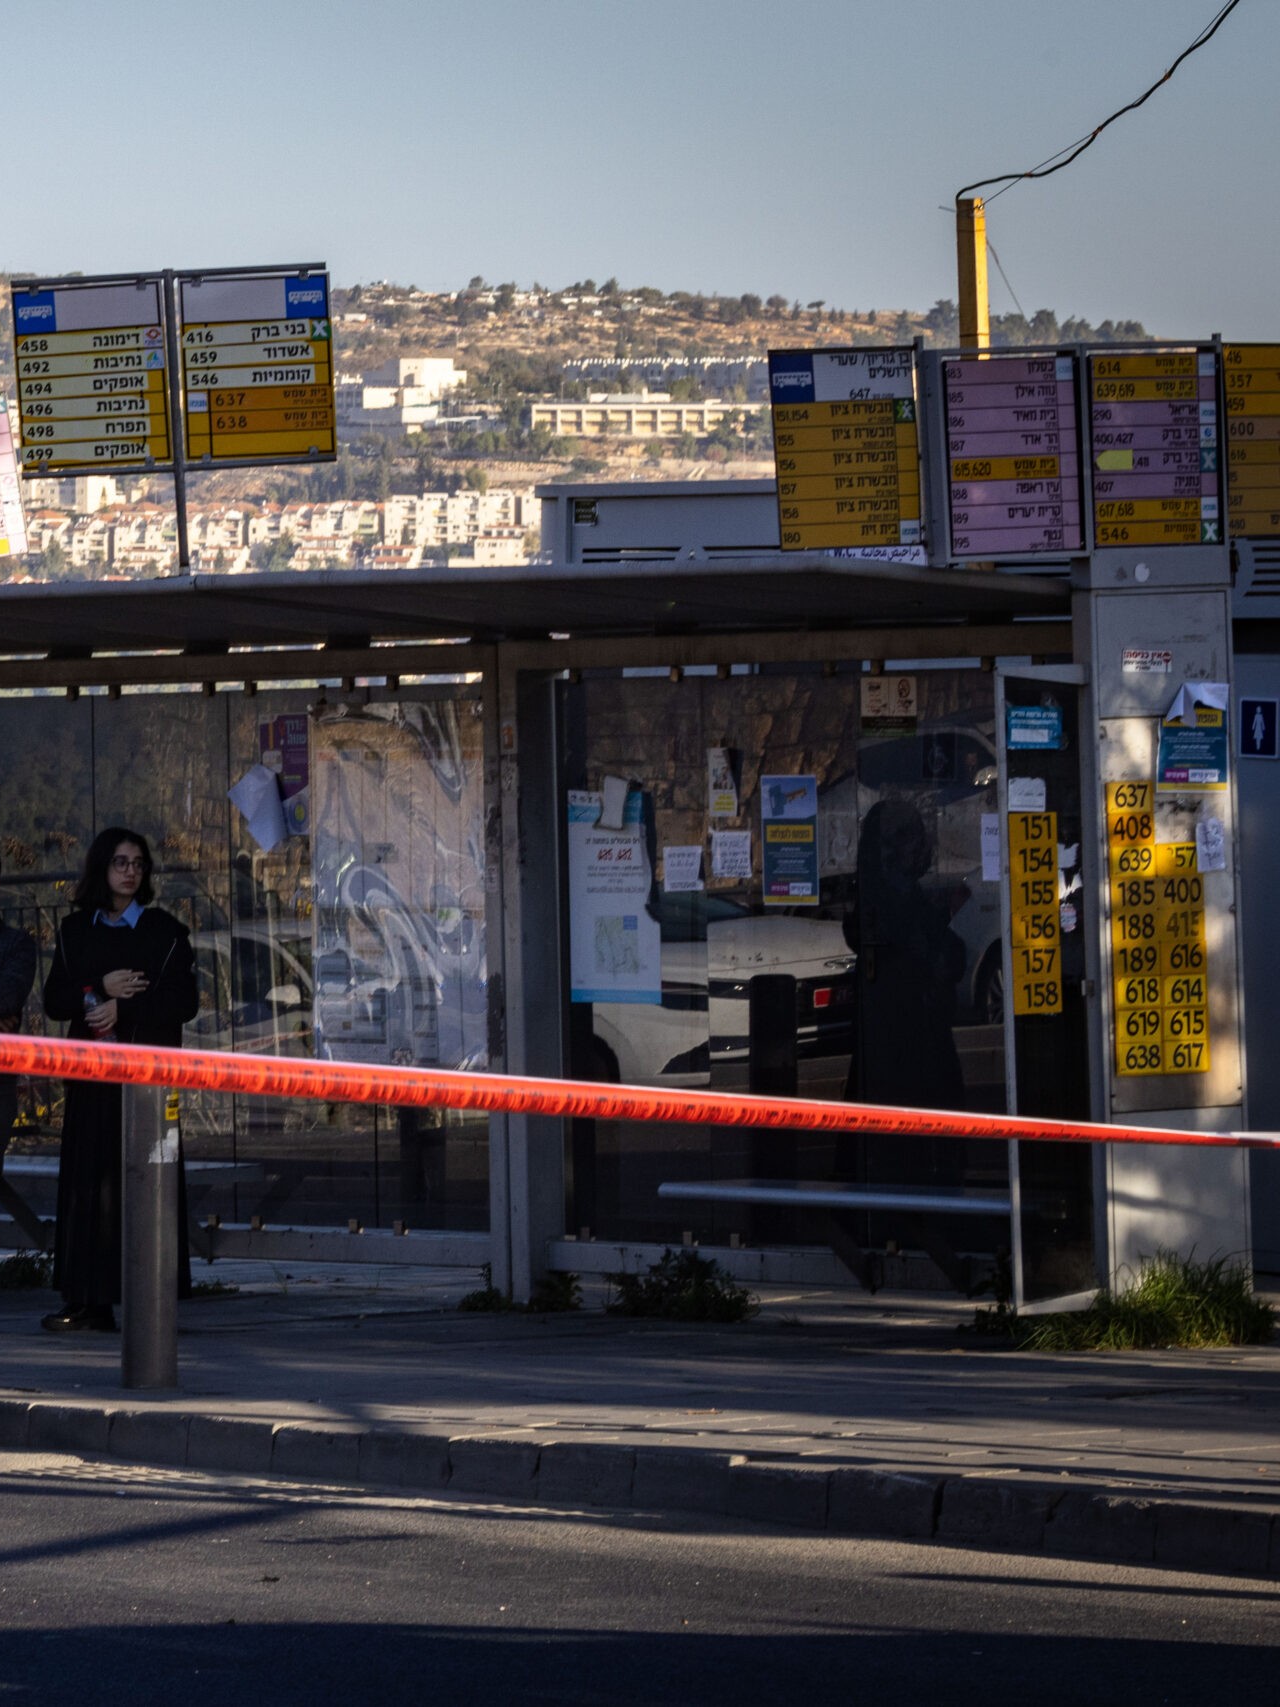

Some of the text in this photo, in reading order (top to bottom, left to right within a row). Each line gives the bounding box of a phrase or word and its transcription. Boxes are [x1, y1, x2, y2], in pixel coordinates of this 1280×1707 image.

[187, 331, 214, 344] 416
[251, 323, 306, 342] בני ברק
[20, 340, 48, 353] 458
[93, 333, 140, 347] דימונה
[190, 352, 218, 364] 459
[262, 344, 309, 358] אשדוד
[22, 361, 50, 373] 492
[93, 356, 142, 369] נתיבות
[1027, 361, 1054, 374] כסלון
[1098, 361, 1121, 375] 614
[191, 373, 218, 386] 546
[252, 368, 311, 383] קוממיות
[1229, 374, 1252, 388] 357
[25, 383, 52, 395] 494
[93, 375, 144, 393] אופקים
[1097, 383, 1135, 399] 639,619
[215, 393, 246, 407] 637
[849, 388, 871, 400] 647
[25, 404, 53, 416] 496
[96, 398, 145, 412] נתיבות
[852, 402, 892, 415] מבשרת
[1227, 398, 1245, 411] 459
[217, 415, 248, 429] 638
[776, 410, 809, 423] 151,154
[1093, 409, 1112, 421] 290
[26, 425, 54, 438] 498
[105, 421, 146, 434] תפרח
[854, 426, 894, 440] מבשרת
[1230, 422, 1254, 436] 600
[777, 434, 795, 446] 155
[26, 448, 53, 460] 499
[94, 443, 145, 458] אופקים
[856, 451, 895, 464] מבשרת
[1230, 449, 1247, 461] 616
[779, 459, 796, 471] 156
[954, 461, 992, 477] 615,620
[857, 475, 896, 487] מבשרת
[1095, 481, 1114, 492] 407
[780, 483, 797, 495] 157
[952, 488, 968, 500] 188
[858, 499, 897, 512] מבשרת
[1098, 503, 1135, 518] 617,618
[782, 507, 799, 519] 158
[953, 513, 969, 524] 189
[880, 523, 897, 535] בית
[1101, 527, 1129, 541] 546
[783, 532, 801, 543] 180
[1115, 784, 1148, 809] 637
[1021, 816, 1052, 840] 151
[1113, 814, 1152, 841] 408
[1019, 848, 1054, 873] 154
[1119, 847, 1151, 871] 639
[1167, 846, 1196, 869] 57
[1021, 881, 1054, 906] 155
[1118, 881, 1155, 906] 185
[1164, 878, 1201, 904] 400
[1021, 914, 1055, 939] 156
[1118, 914, 1155, 939] 188
[1022, 948, 1056, 973] 157
[1120, 947, 1157, 973] 189
[1170, 943, 1202, 969] 616
[1023, 982, 1058, 1008] 158
[1126, 978, 1160, 1003] 618
[1171, 979, 1204, 1003] 614
[1126, 1011, 1161, 1037] 619
[1171, 1010, 1205, 1035] 615
[1126, 1045, 1161, 1071] 638
[1173, 1043, 1203, 1069] 617
